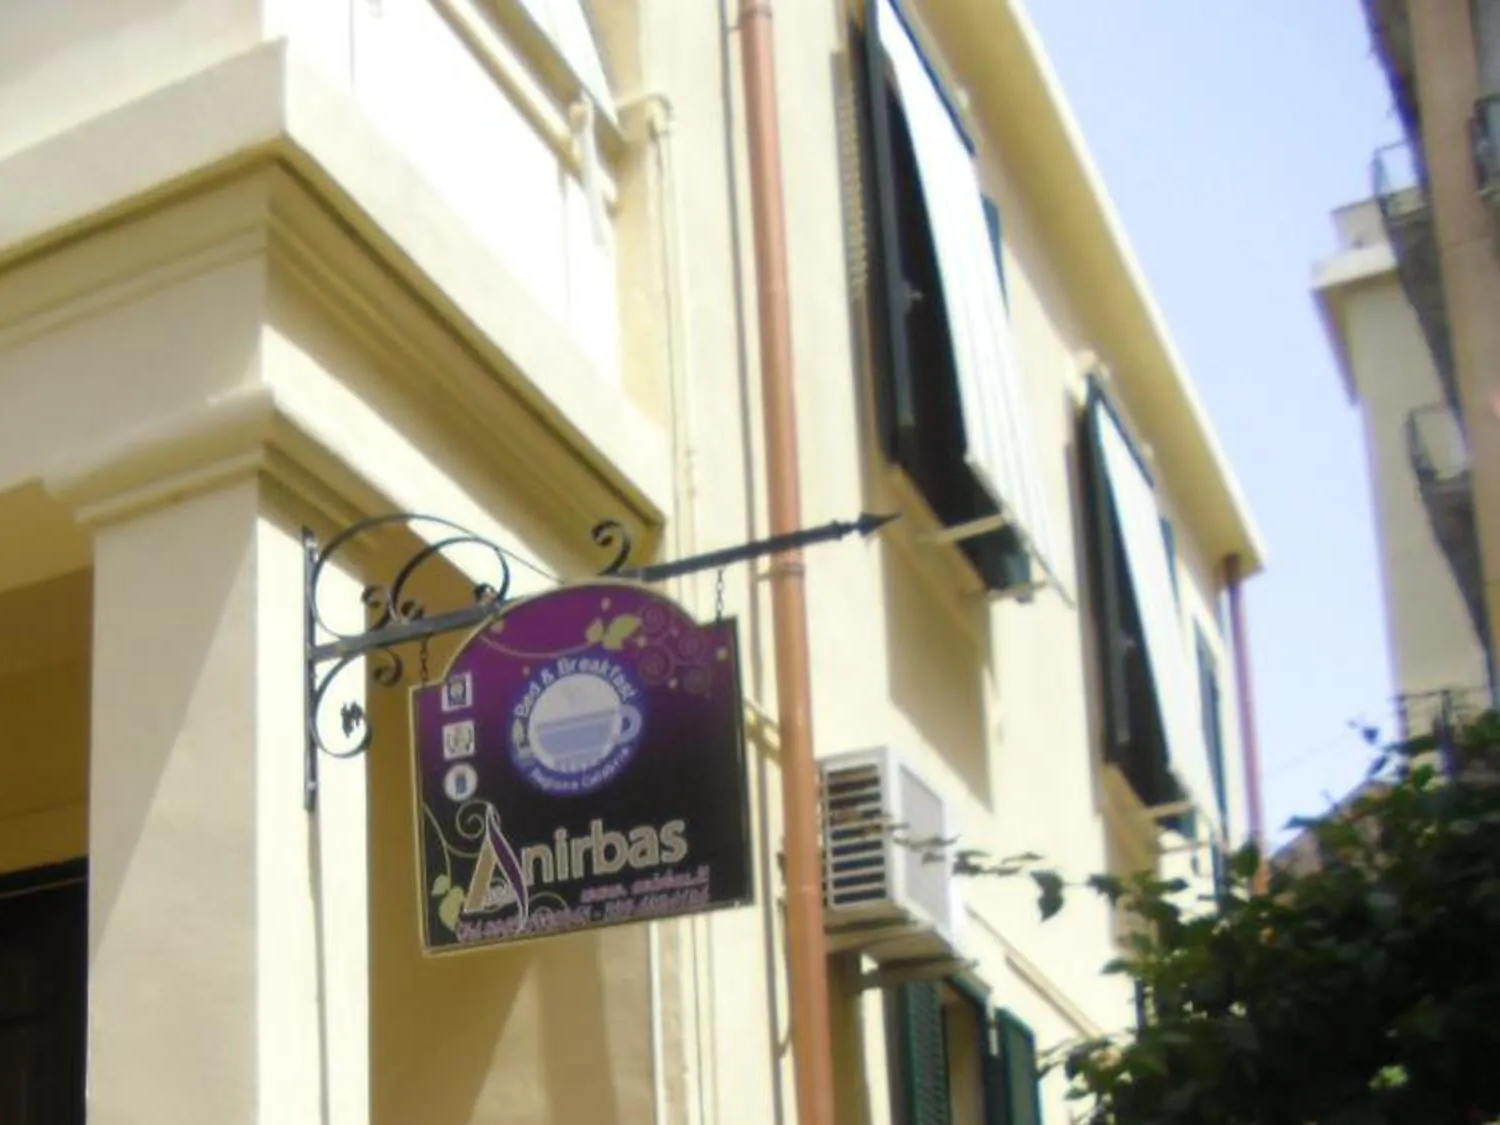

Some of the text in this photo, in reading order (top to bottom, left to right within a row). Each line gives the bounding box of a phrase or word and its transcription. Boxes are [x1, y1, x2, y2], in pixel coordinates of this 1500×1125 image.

[513, 680, 541, 718] Bed
[557, 656, 638, 701] Breakfast
[462, 802, 689, 933] Anirbas
